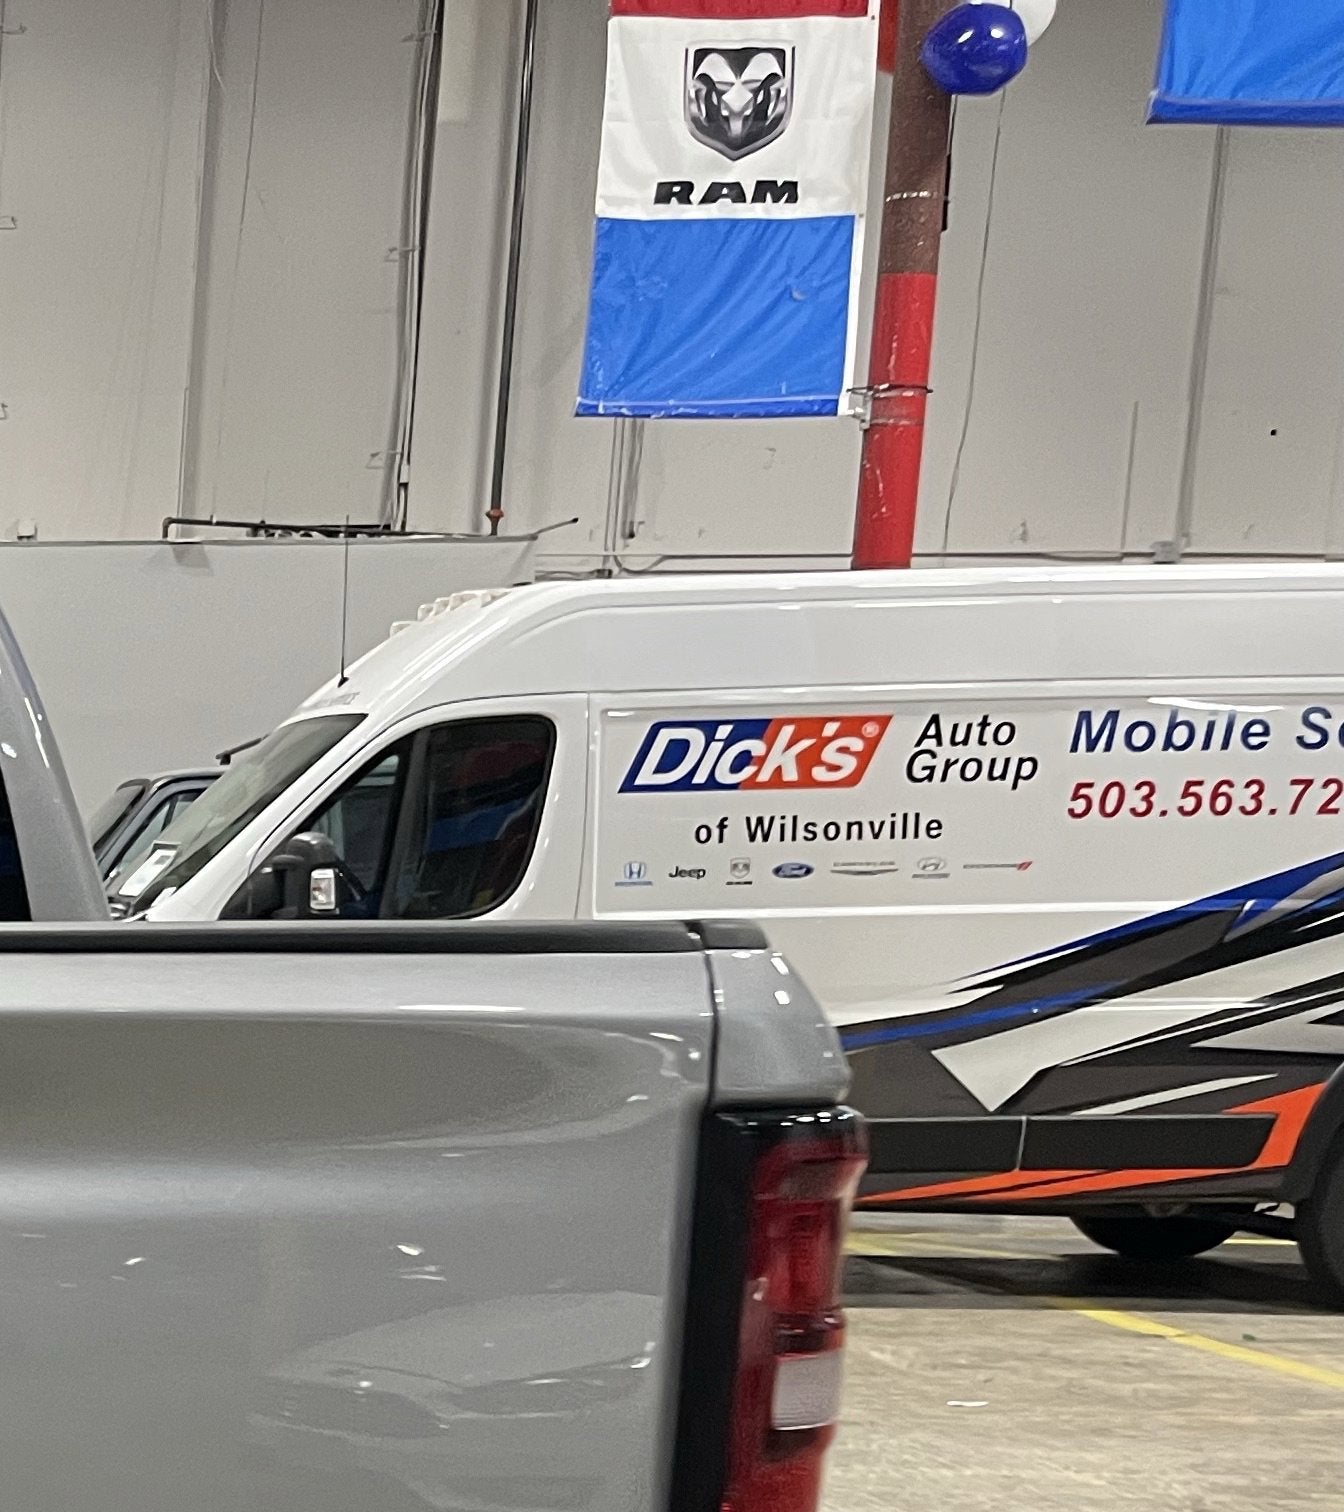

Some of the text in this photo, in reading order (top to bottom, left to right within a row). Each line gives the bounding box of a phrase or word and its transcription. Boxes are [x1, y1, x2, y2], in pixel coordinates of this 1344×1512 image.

[653, 180, 799, 206] RAM
[914, 714, 1016, 748] Auto
[1069, 706, 1344, 754] Mobile S
[905, 749, 1039, 791] Group
[694, 812, 944, 845] of Wilsonville
[668, 866, 707, 880] Jeep
